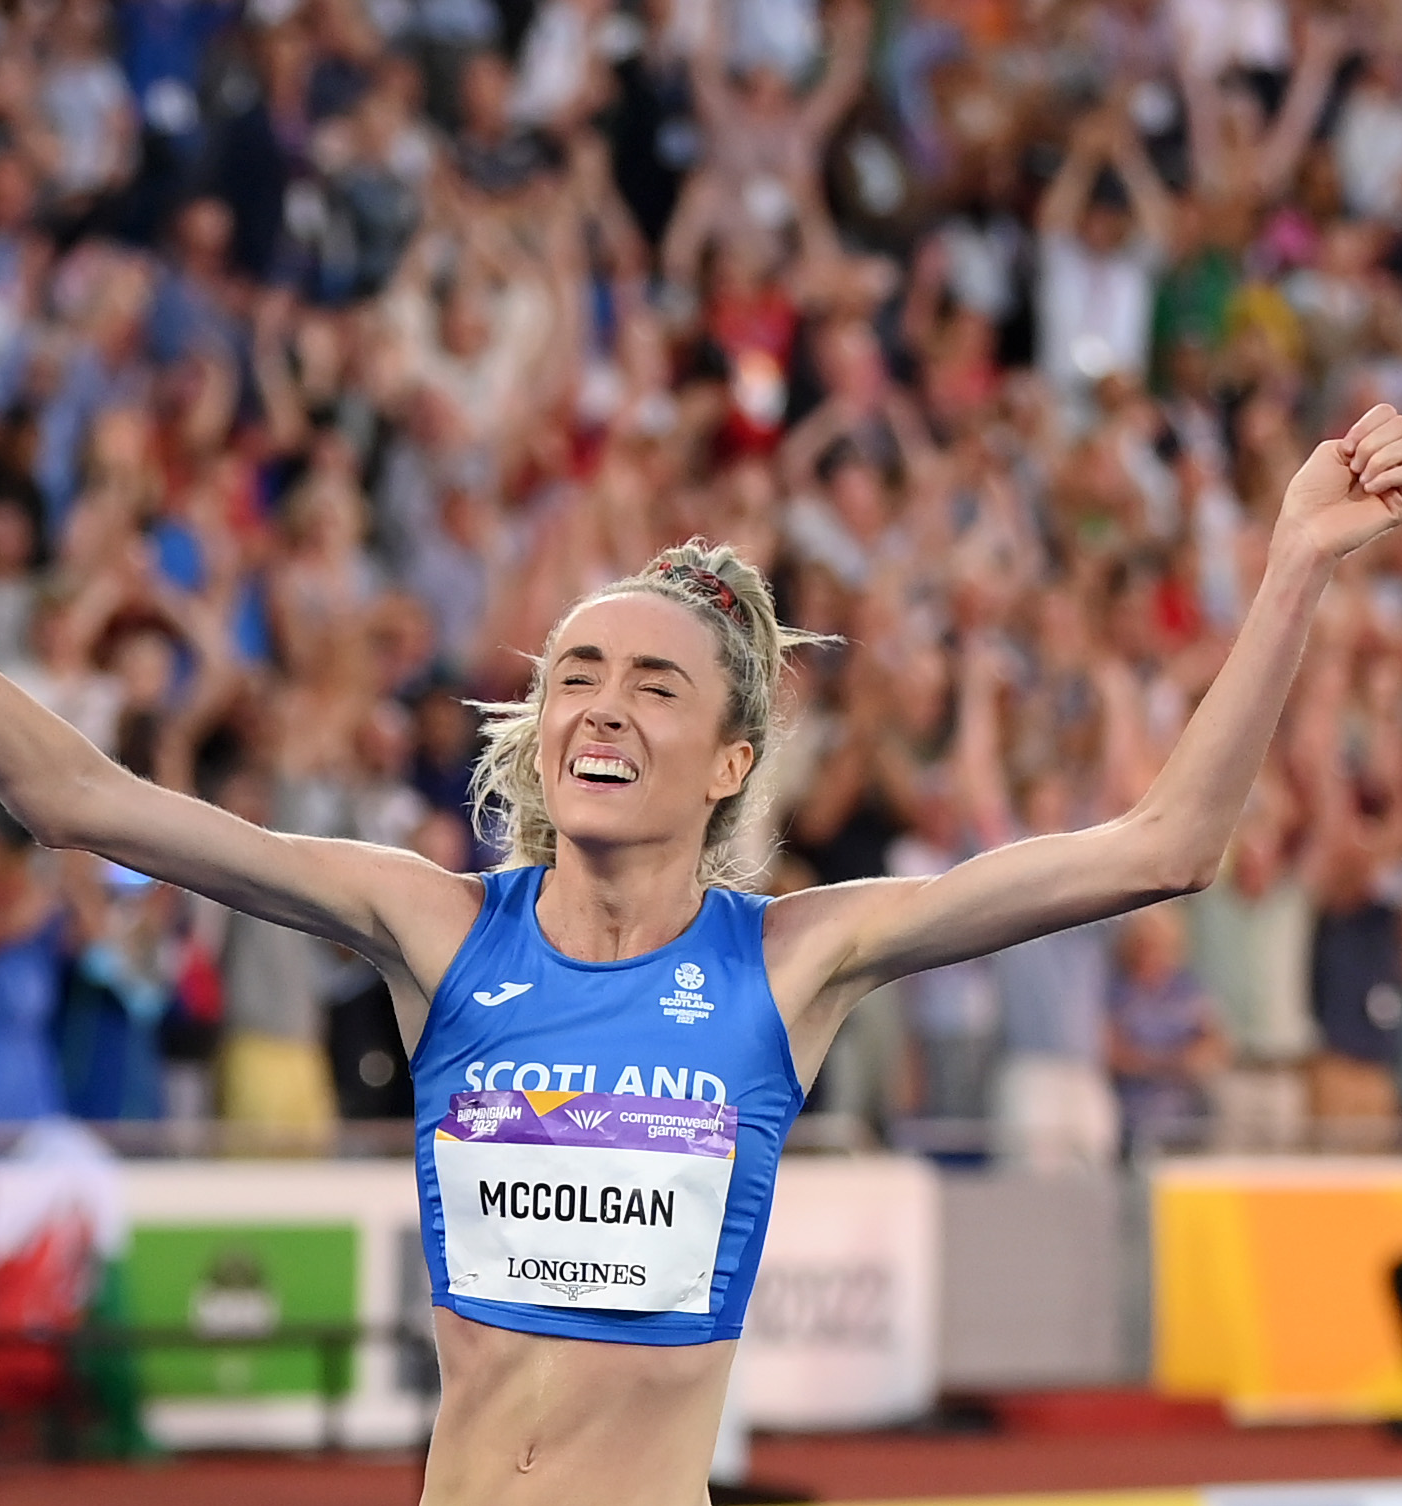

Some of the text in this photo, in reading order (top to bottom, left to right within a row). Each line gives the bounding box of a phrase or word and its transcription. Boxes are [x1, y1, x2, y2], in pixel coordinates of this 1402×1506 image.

[673, 990, 703, 1001] TEAM
[659, 997, 715, 1011] SCOTLAND
[457, 1105, 522, 1123] BIRMINGHAM
[470, 1119, 498, 1133] 2022
[647, 1125, 696, 1139] games
[479, 1180, 675, 1228] MCCOLGAN
[507, 1257, 646, 1286] LONGINES
